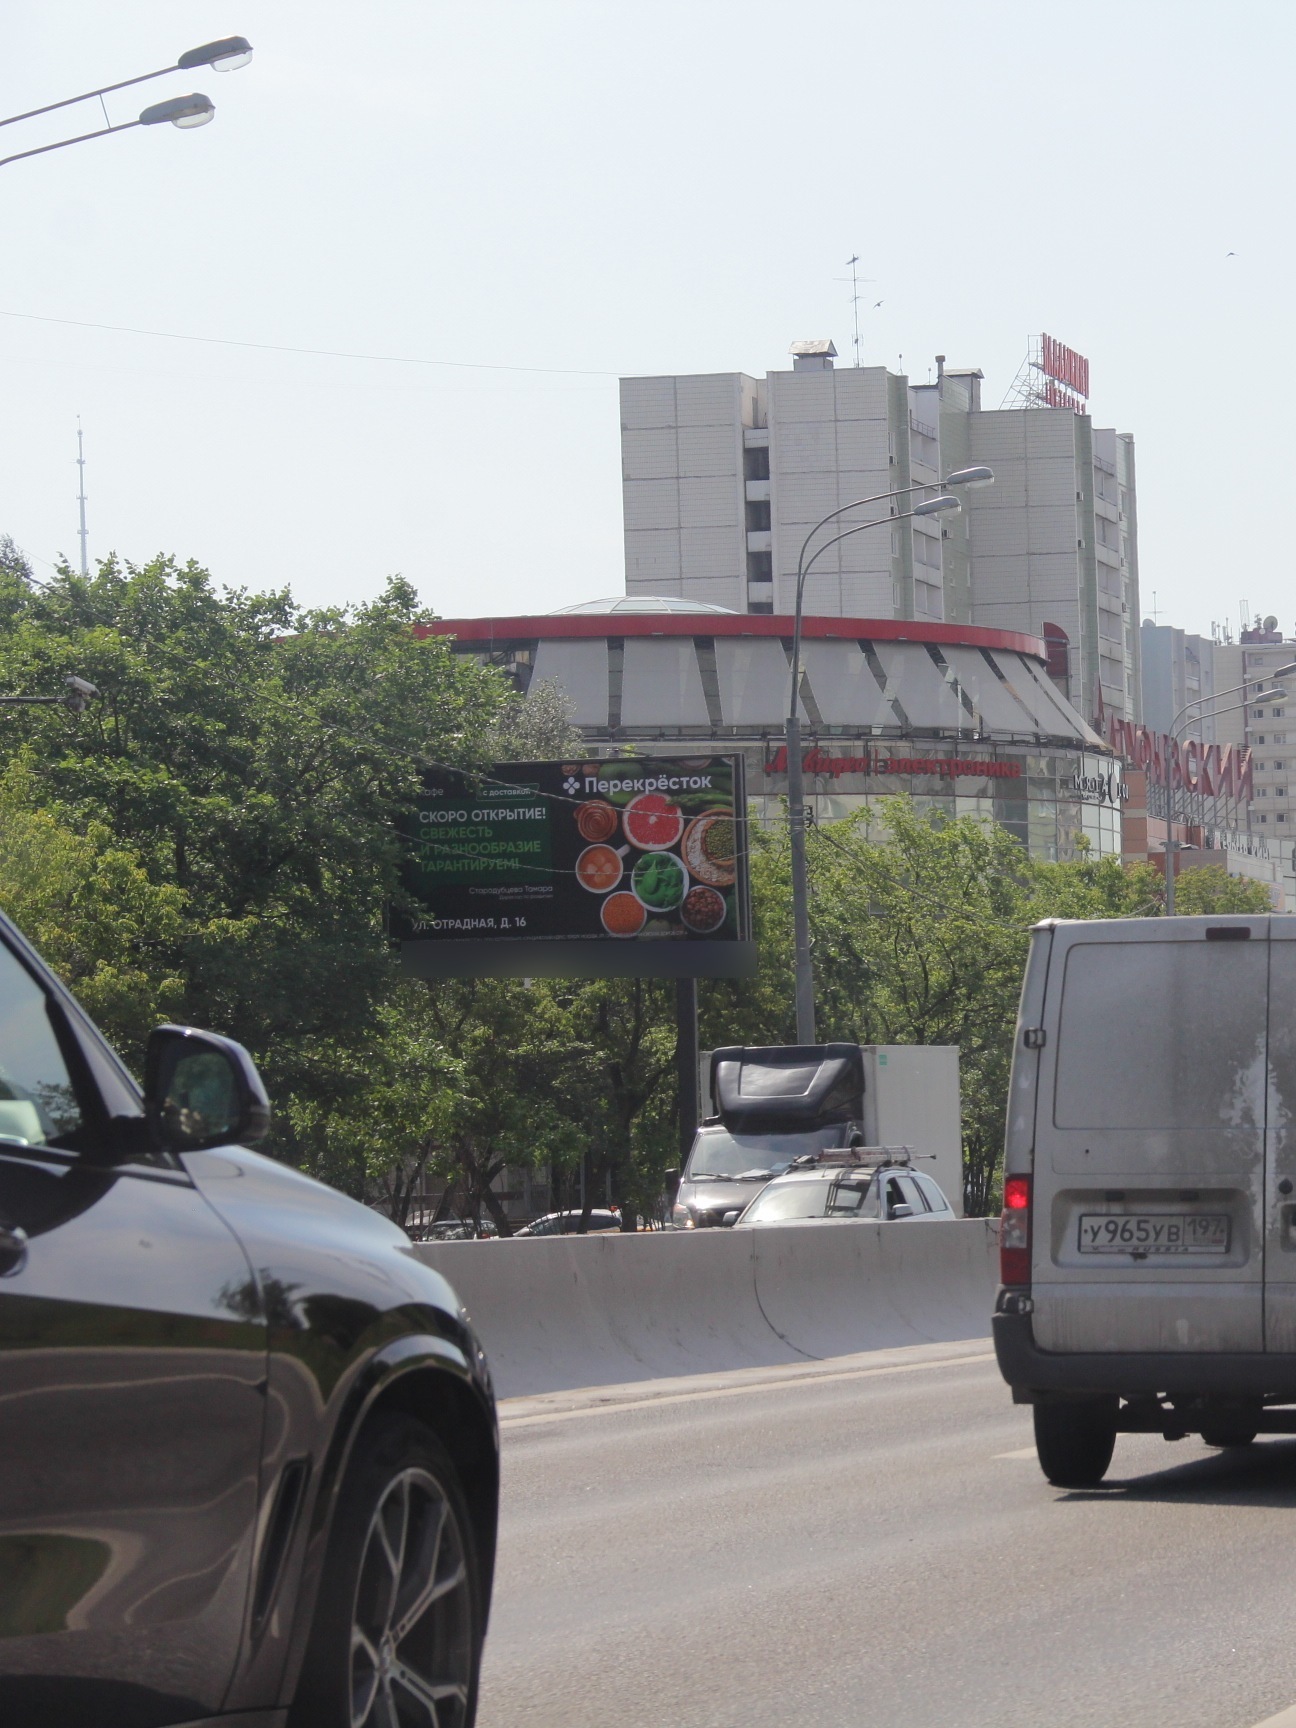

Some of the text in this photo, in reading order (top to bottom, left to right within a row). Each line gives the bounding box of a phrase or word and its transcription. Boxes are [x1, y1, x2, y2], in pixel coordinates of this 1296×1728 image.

[585, 774, 712, 795] Перекрёсток
[421, 788, 444, 797] афе
[420, 807, 547, 823] СКОРО ОТКРЫТИЕ!
[420, 826, 493, 840] СВЕЖЕСТЬ
[421, 840, 541, 856] И РАЗНООБРАЗИЕ
[421, 858, 520, 872] ГАРАНТИРУЕМ!
[525, 884, 553, 894] Тамара
[433, 918, 497, 930] ОТРАДНАЯ,
[500, 917, 512, 929] Д.
[515, 916, 527, 927] 16
[1090, 1219, 1181, 1244] У965УВ
